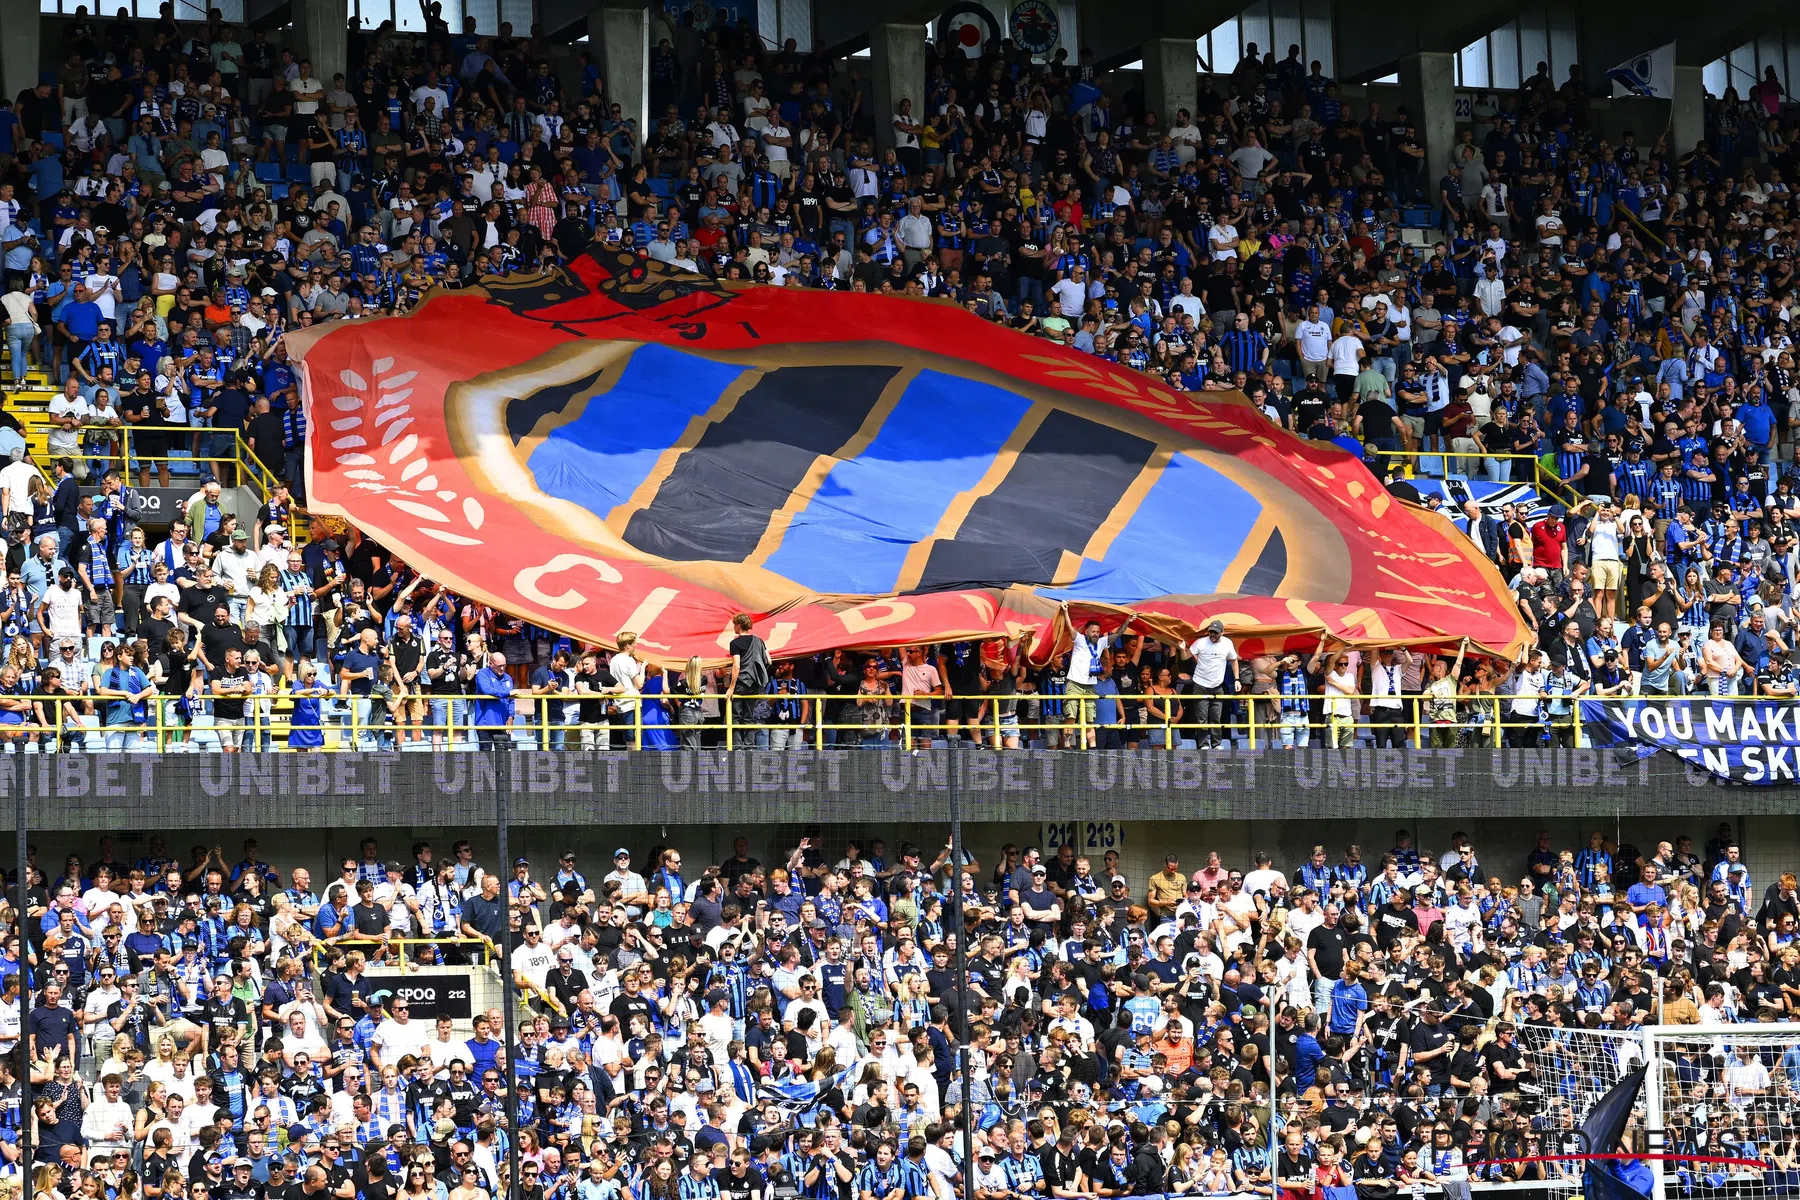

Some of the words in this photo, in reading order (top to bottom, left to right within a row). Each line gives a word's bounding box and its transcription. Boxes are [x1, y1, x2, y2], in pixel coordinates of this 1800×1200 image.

[1455, 98, 1470, 116] 23
[802, 197, 818, 206] 1891
[1612, 706, 1694, 740] YOU
[200, 752, 400, 796] UNIBET
[434, 750, 628, 794] UNIBET
[661, 750, 848, 792] UNIBET
[881, 749, 1062, 791] UNIBET
[1088, 749, 1264, 790] UNIBET
[1294, 749, 1464, 789] UNIBET
[1048, 822, 1073, 848] 212
[1087, 822, 1115, 848] 213
[527, 956, 548, 967] 1891
[397, 987, 436, 1001] SPOQ
[448, 990, 466, 999] 212
